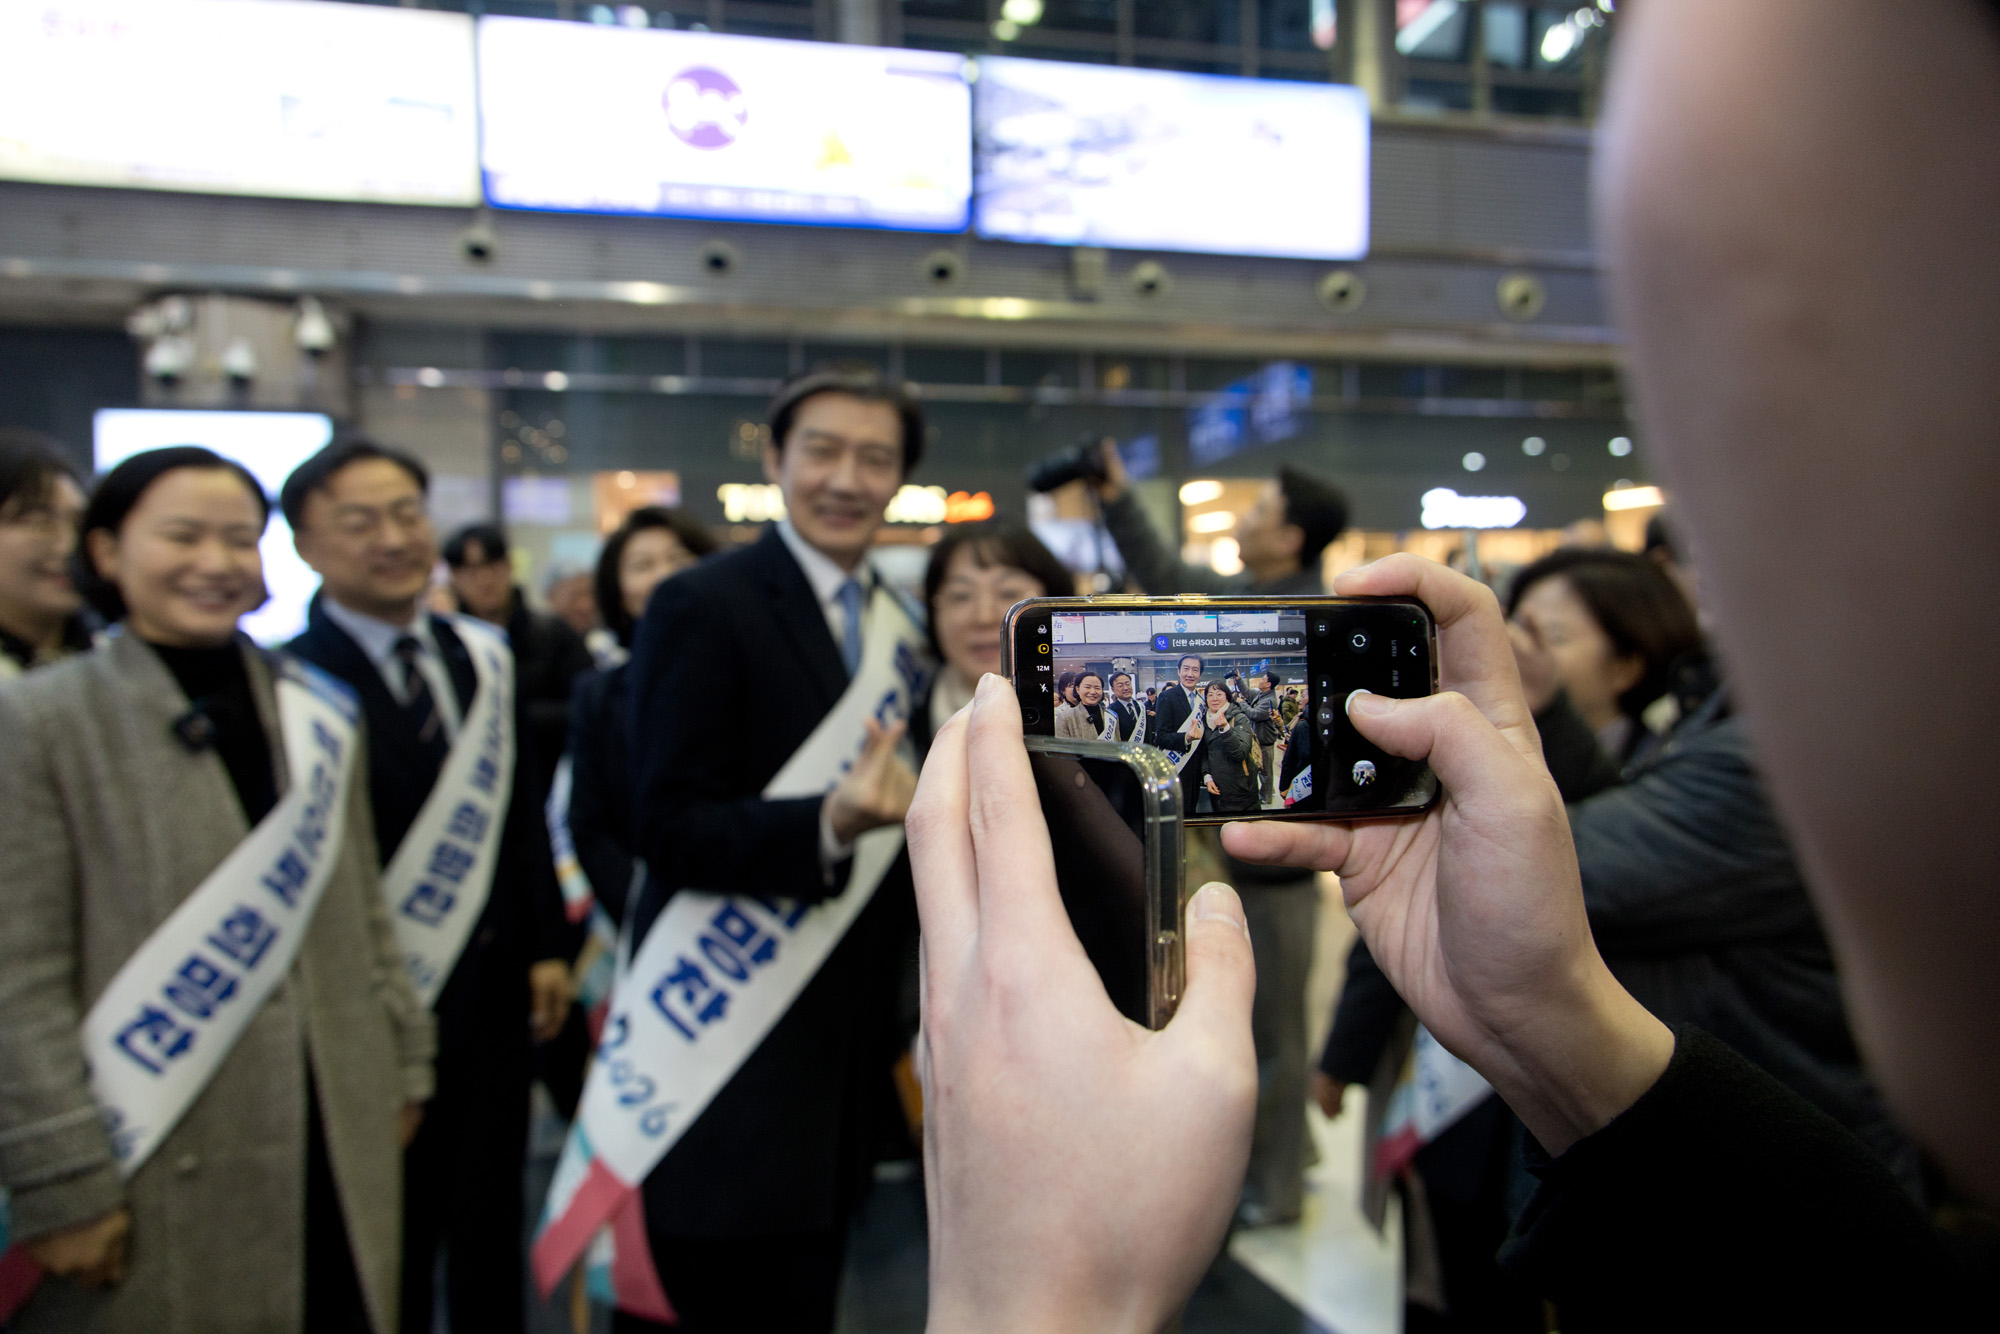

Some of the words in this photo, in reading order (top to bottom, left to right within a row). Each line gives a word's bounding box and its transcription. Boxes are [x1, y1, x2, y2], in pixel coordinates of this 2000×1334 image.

[1240, 638, 1259, 646] 포인트
[1287, 637, 1300, 645] 안내
[648, 897, 819, 1046] 망찬
